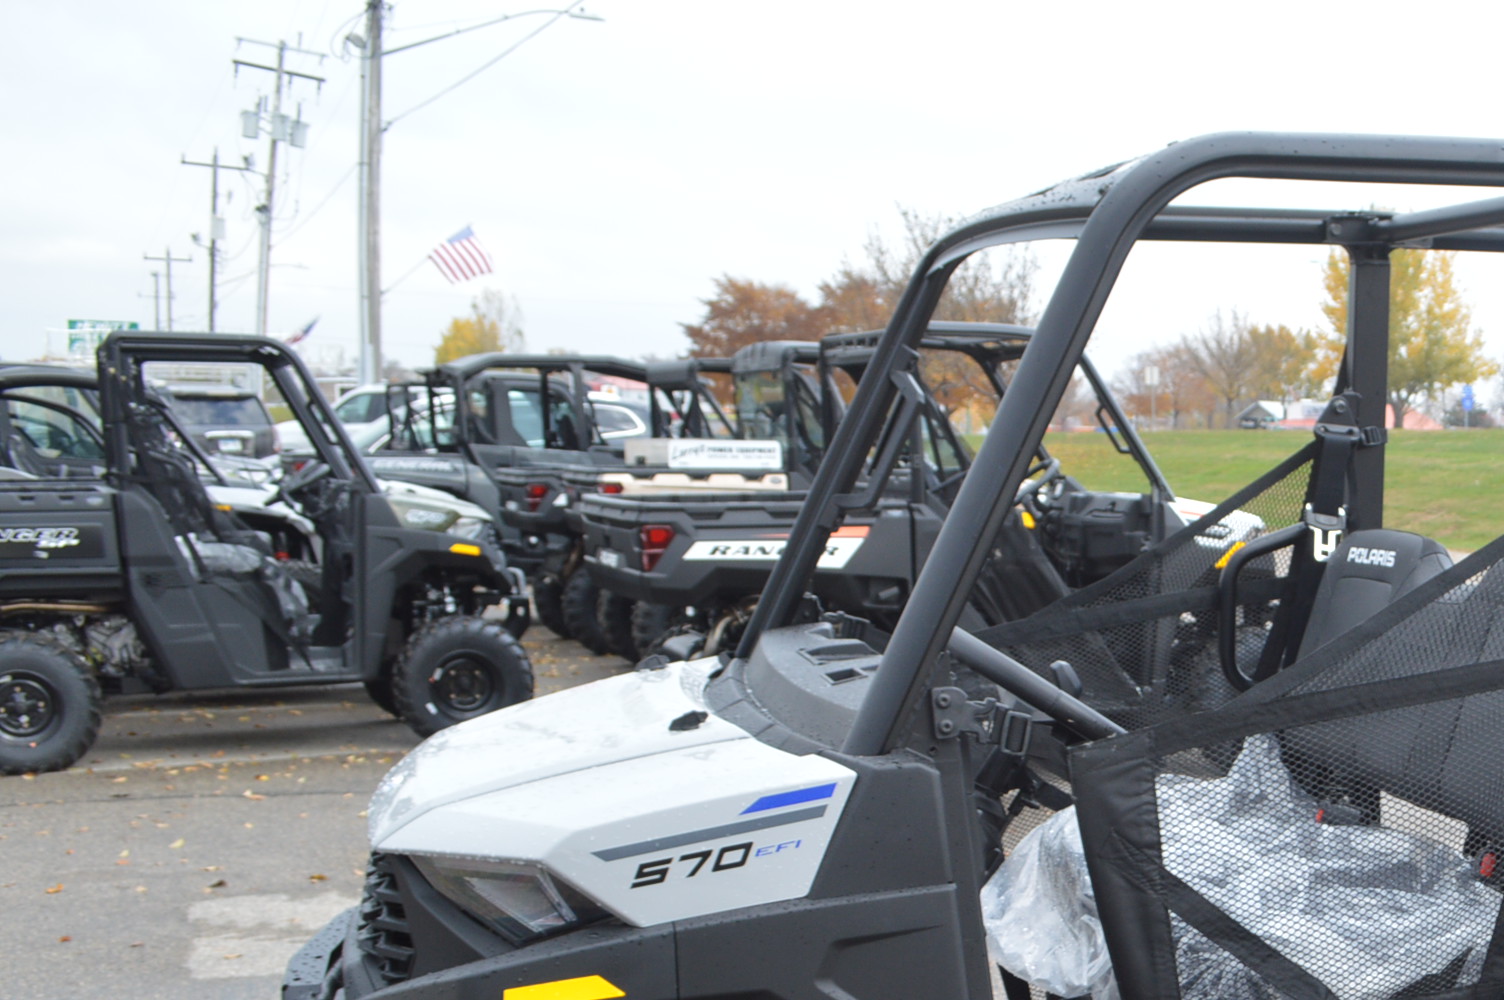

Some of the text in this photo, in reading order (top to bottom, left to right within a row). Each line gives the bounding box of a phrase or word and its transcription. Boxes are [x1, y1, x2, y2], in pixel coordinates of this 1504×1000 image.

[1347, 547, 1396, 567] POLARIS
[630, 839, 802, 889] 570 EFI
